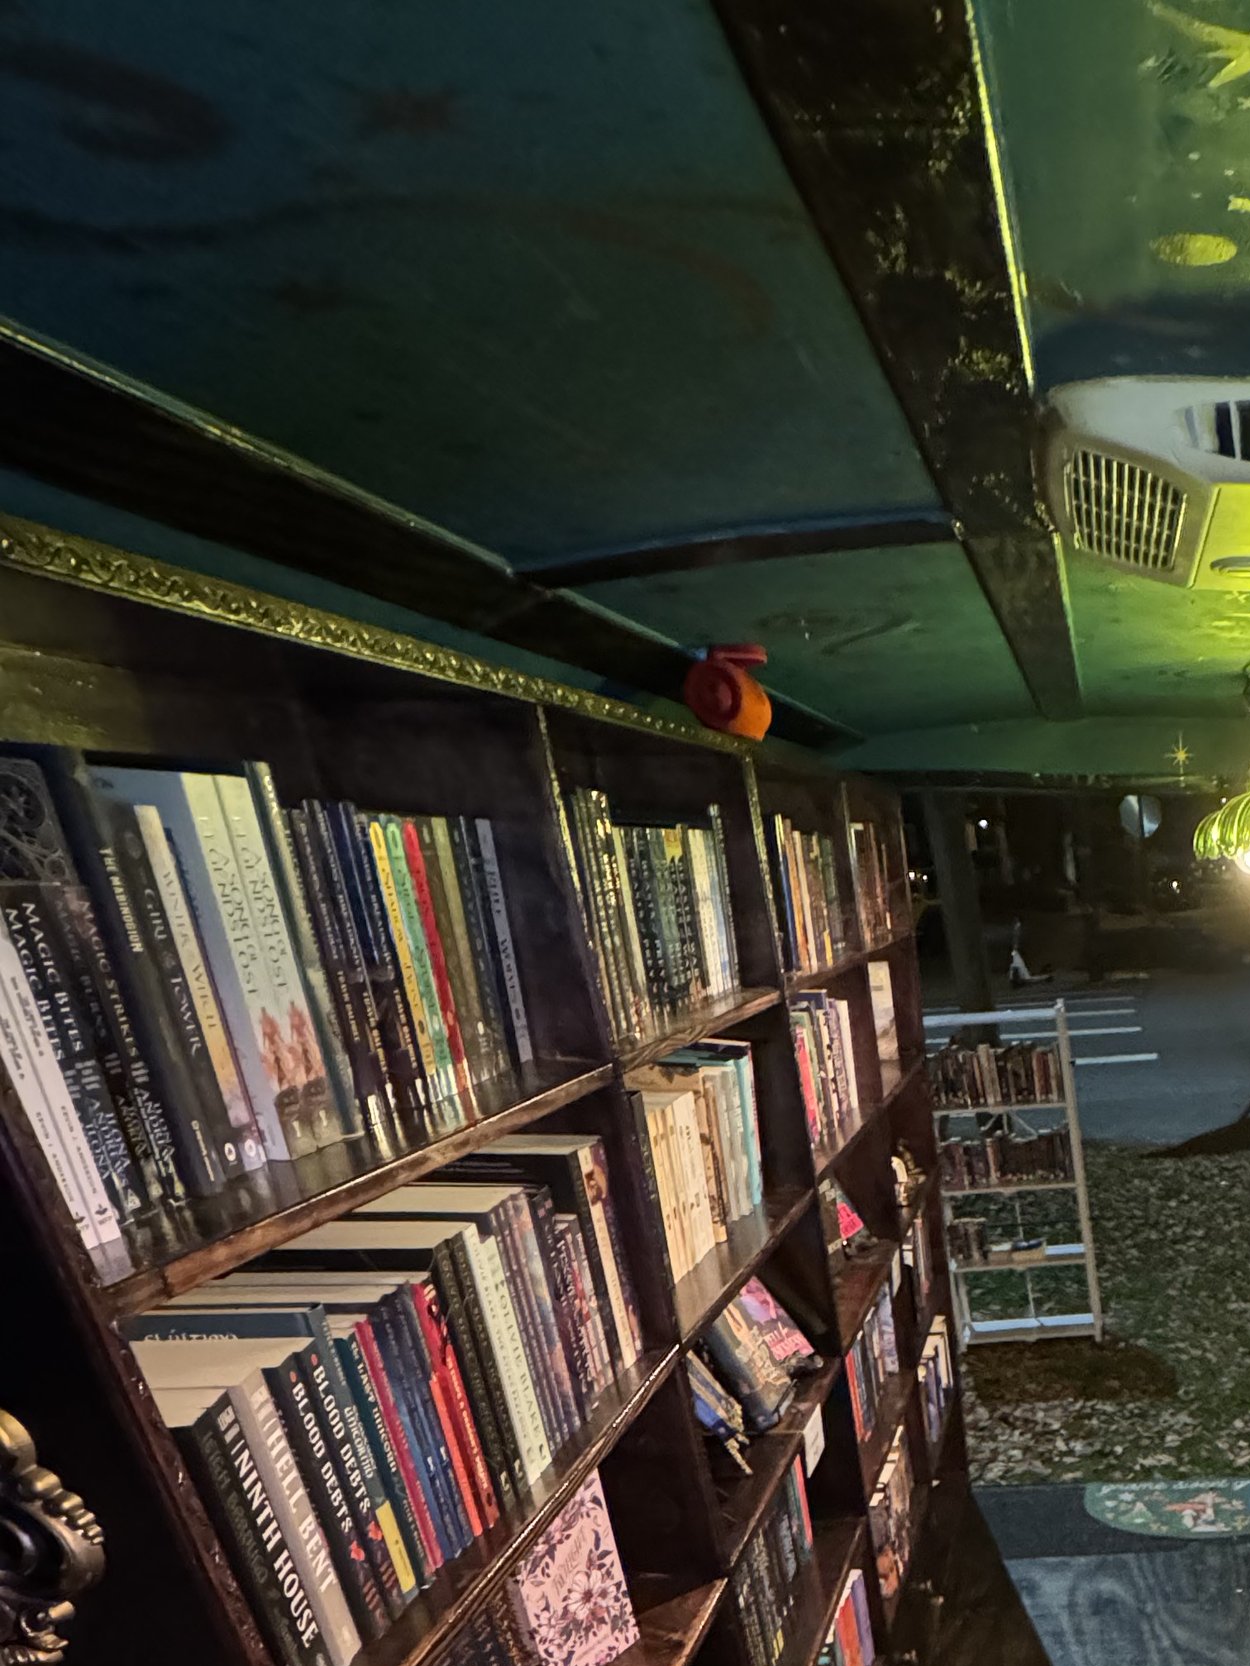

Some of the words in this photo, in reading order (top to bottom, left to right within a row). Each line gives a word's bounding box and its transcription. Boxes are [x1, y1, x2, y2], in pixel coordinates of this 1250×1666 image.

[98, 845, 118, 875] THE
[3, 905, 44, 991] MAGIC
[35, 996, 68, 1061] BITES
[20, 898, 62, 985] MAGIC
[52, 989, 87, 1053] BITES
[76, 897, 112, 974] MAGIC
[105, 978, 139, 1058] STRIKES
[167, 972, 206, 1057] TOWER
[307, 1364, 352, 1442] BLOOD
[335, 1443, 377, 1515] DEBTS
[492, 1292, 527, 1370] OLIVIE
[516, 1374, 546, 1438] BLAKE
[259, 1426, 310, 1515] HELL
[290, 1512, 340, 1593] BENT
[287, 1381, 332, 1459] BLOOD
[316, 1459, 361, 1534] DEBTS
[231, 1443, 290, 1553] NINTH
[268, 1552, 323, 1649] HOUSE
